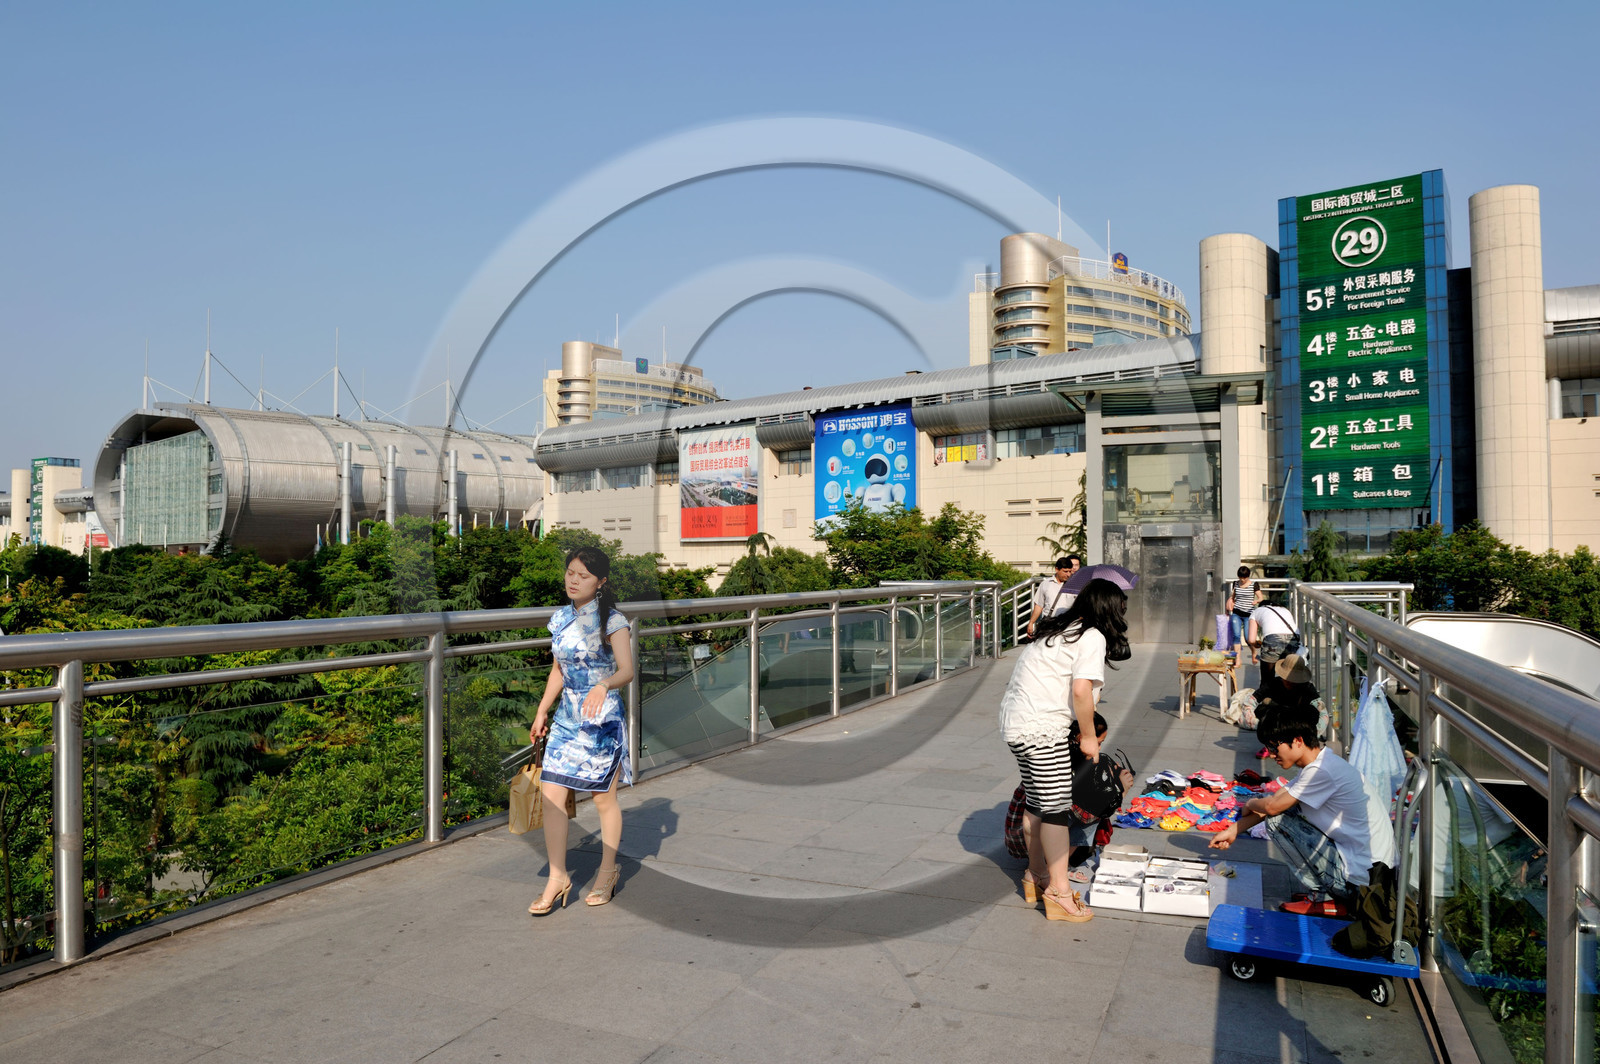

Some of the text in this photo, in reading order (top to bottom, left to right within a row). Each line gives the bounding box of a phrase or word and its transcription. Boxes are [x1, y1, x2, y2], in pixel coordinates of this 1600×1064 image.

[1311, 184, 1404, 212] 国际商贸城二区
[1303, 214, 1327, 222] DISTRICT
[1332, 206, 1374, 216] INTERNATIONAL
[1396, 197, 1414, 205] MART
[1340, 227, 1380, 258] 29
[1343, 268, 1416, 292] 外贸采购服务
[1306, 285, 1336, 312] 5 楼 F
[1343, 286, 1411, 302] Procurement Service
[1360, 300, 1384, 309] Foreign
[1386, 296, 1406, 306] Trade
[1346, 318, 1416, 342] 五金·电器
[1307, 332, 1338, 356] 4 楼 F
[1348, 344, 1412, 358] Electric Appliances
[1363, 340, 1394, 349] Hardware
[1347, 368, 1416, 388] 小家电
[1309, 377, 1339, 402] 3 楼 F
[1345, 388, 1420, 401] Small Home Appliances
[880, 413, 906, 427] 鸿宝
[1345, 414, 1414, 435] 五金工具
[1310, 425, 1339, 449] 2 楼 F
[1351, 441, 1401, 451] Hardware Tools
[690, 456, 749, 472] 国际贸易综合改革试点建设
[1353, 464, 1413, 482] 箱包
[1311, 472, 1340, 496] 1 楼 F
[1353, 490, 1386, 499] Suitcases
[1394, 489, 1412, 498] Bags
